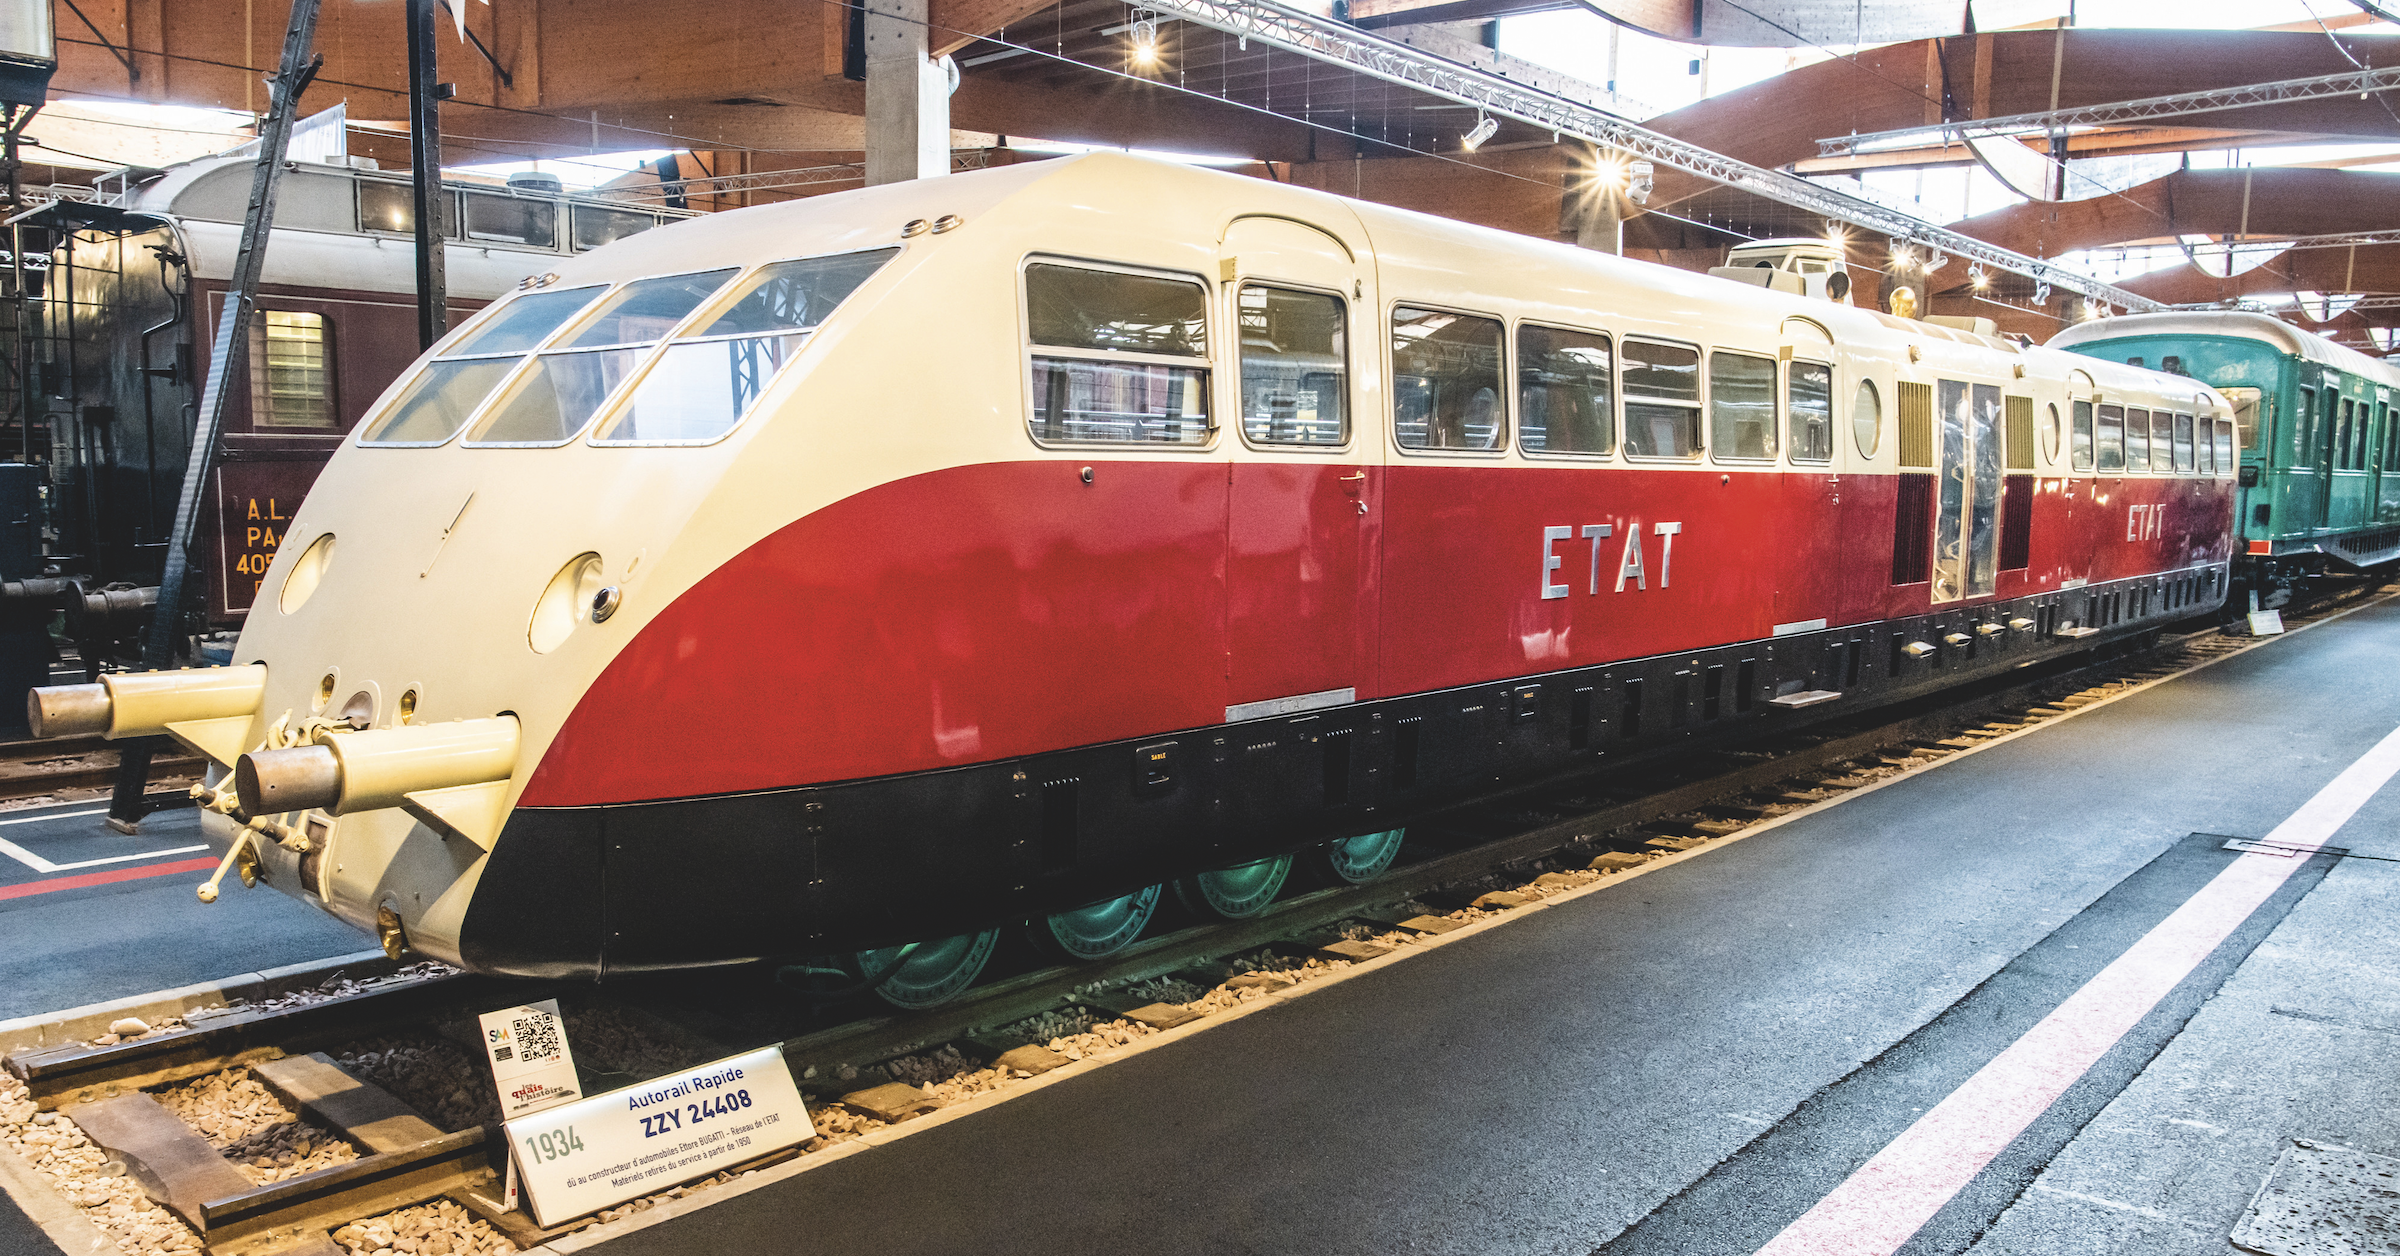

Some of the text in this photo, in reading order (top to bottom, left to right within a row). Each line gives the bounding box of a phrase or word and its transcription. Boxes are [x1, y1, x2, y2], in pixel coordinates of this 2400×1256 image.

[2127, 503, 2167, 542] ETAT
[1541, 521, 1682, 599] ETAT
[511, 1084, 543, 1099] quais
[629, 1068, 744, 1111] Autorail Rapide
[639, 1089, 752, 1138] ZZY 24408
[525, 1125, 584, 1165] 1934
[578, 1176, 587, 1185] au
[588, 1161, 631, 1181] constructeur
[679, 1140, 699, 1153] Ettore
[698, 1130, 726, 1146] BUGATTI
[730, 1125, 755, 1136] Réseau
[755, 1120, 763, 1129] de
[763, 1113, 780, 1126] l'ETAT
[611, 1136, 752, 1188] Matériels retirés du service à partir de 1950
